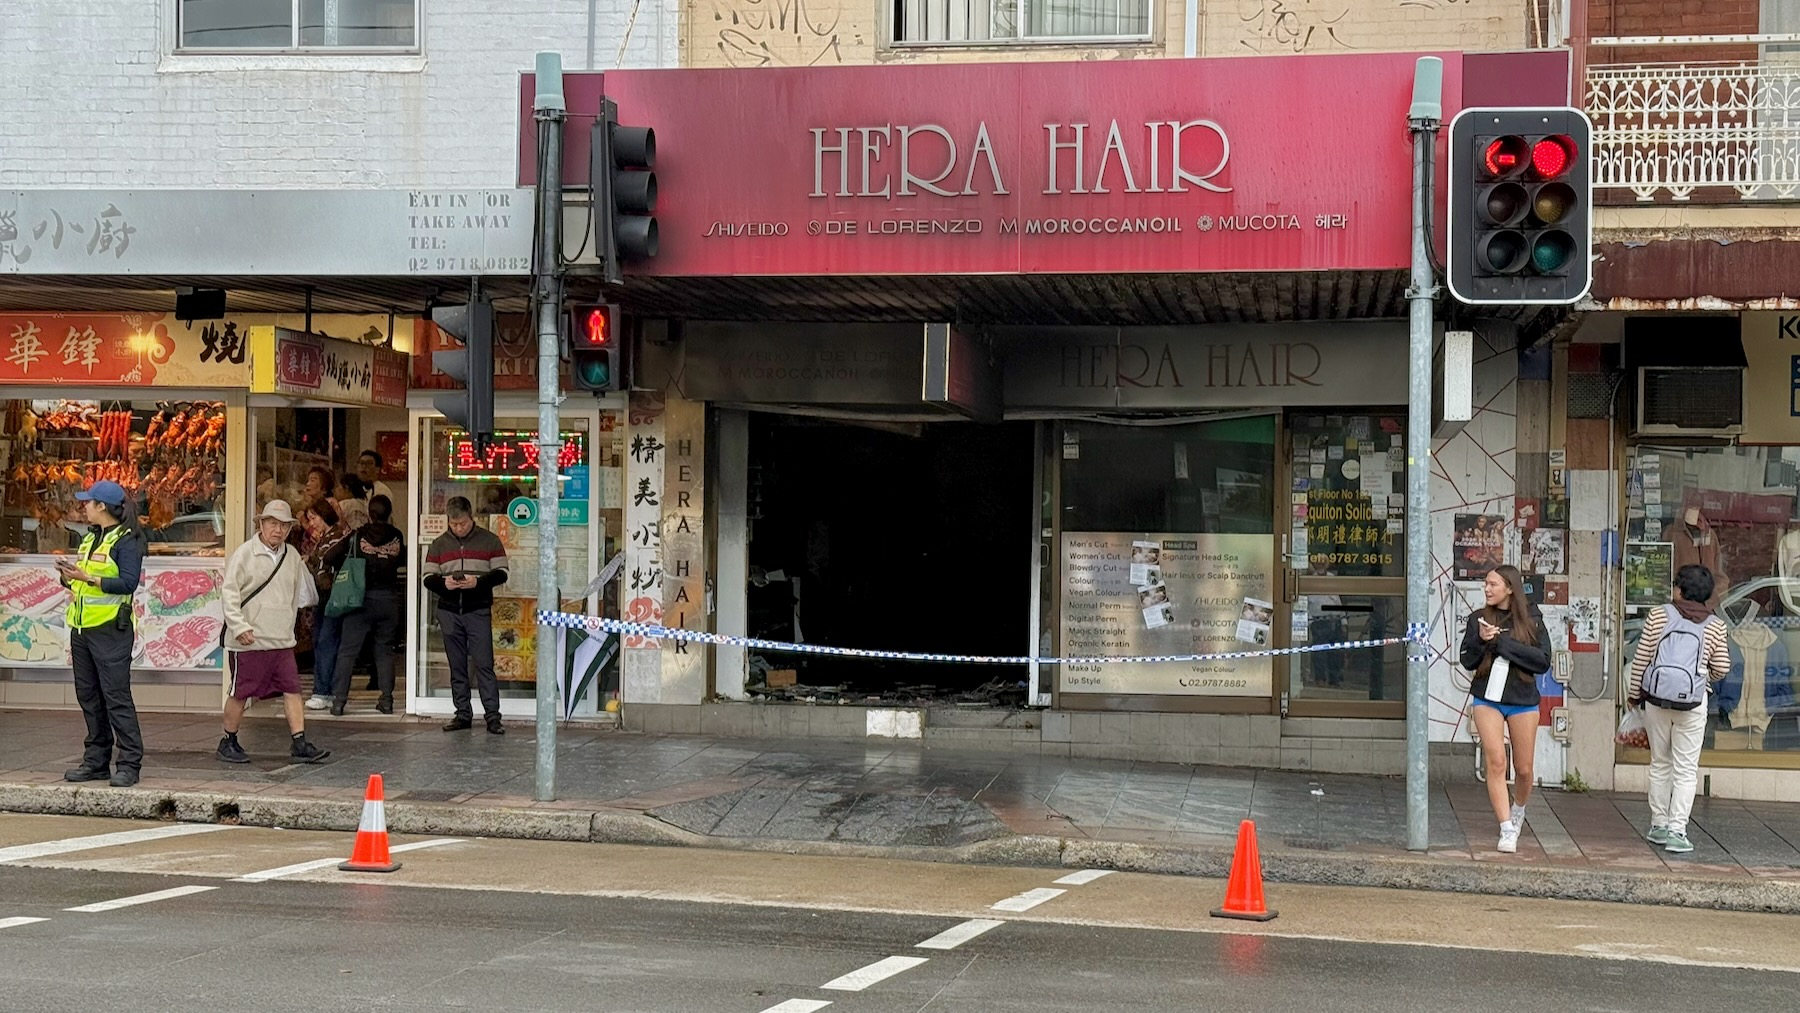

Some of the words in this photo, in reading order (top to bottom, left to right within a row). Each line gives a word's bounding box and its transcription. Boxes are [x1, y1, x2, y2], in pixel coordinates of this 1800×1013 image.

[808, 120, 1010, 199] HERA
[1042, 118, 1234, 194] HAIR
[408, 191, 441, 208] EAT
[449, 195, 468, 208] IN
[486, 194, 510, 208] OR
[408, 215, 455, 228] TAKE
[463, 215, 511, 228] AWAY
[702, 221, 790, 237] SHISEIDO
[825, 220, 858, 234] DE
[867, 219, 983, 234] LORENZO
[1025, 216, 1183, 234] MOROCCANOIL
[1218, 213, 1301, 231] MUCOTA
[1314, 213, 1348, 230] 헤라
[408, 236, 446, 249] TEL:
[408, 257, 428, 271] 02
[436, 257, 480, 270] 9718
[485, 257, 529, 270] 0882
[4, 320, 104, 376] 華鋒
[1056, 342, 1184, 389] HERA
[1205, 341, 1323, 387] HAIR
[677, 438, 692, 534] HERA
[1318, 488, 1340, 499] Floor
[1341, 489, 1354, 500] No
[1307, 502, 1343, 523] quiton
[1069, 540, 1093, 549] Men's
[1094, 540, 1108, 549] Cut
[1069, 552, 1105, 560] Women's
[1106, 552, 1121, 560] Cut
[1162, 553, 1200, 562] Signature
[1201, 553, 1222, 561] Head
[1223, 553, 1239, 562] Spa
[1329, 552, 1360, 564] 9787
[1361, 553, 1393, 565] 3615
[1069, 564, 1101, 573] Blowdry
[1103, 564, 1117, 572] Cut
[1069, 577, 1095, 585] Colour
[1161, 571, 1178, 579] Hair
[1207, 571, 1229, 581] Scalp
[1230, 571, 1265, 580] Dandruff
[1069, 589, 1094, 597] Vegan
[1095, 589, 1121, 597] Colour
[1193, 597, 1239, 606] SHISEIDO
[675, 560, 691, 655] HAIR
[1068, 615, 1094, 623] Digital
[1068, 627, 1092, 636] Magic
[1093, 627, 1126, 636] Straight
[1068, 639, 1099, 648] Organic
[1101, 639, 1130, 648] Keratin
[1068, 664, 1089, 672] Make
[1090, 664, 1102, 673] Up
[1068, 677, 1080, 685] Up
[1081, 677, 1101, 686] Style
